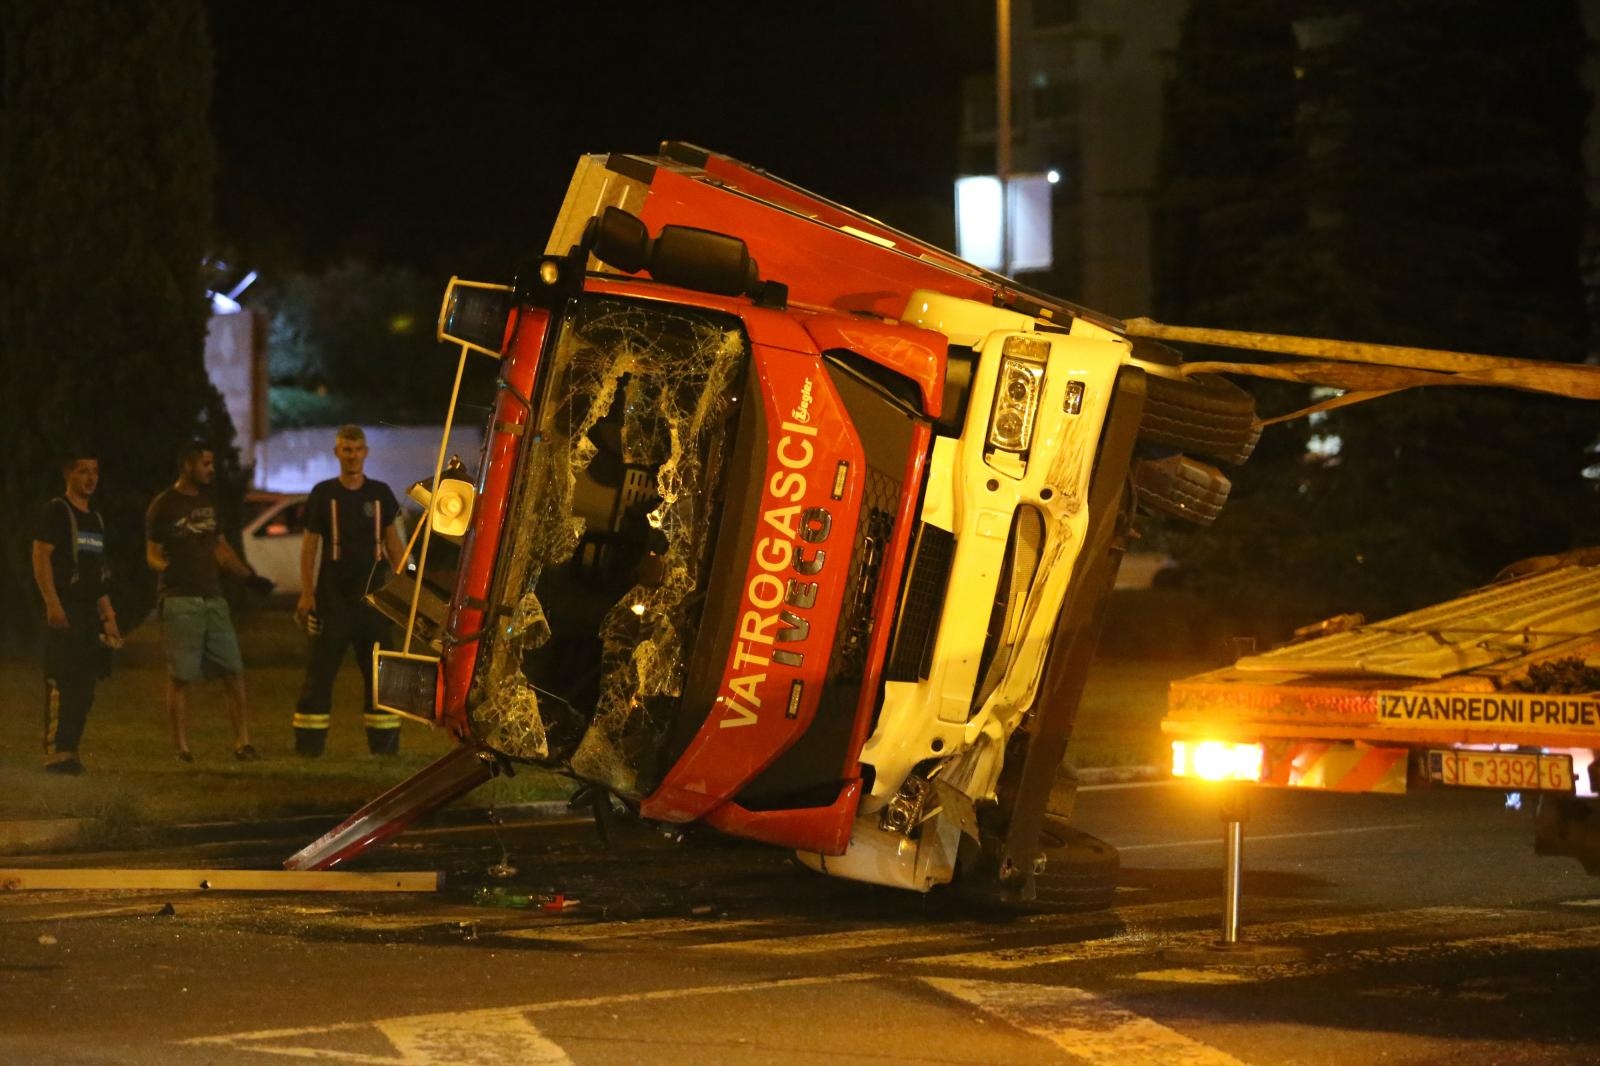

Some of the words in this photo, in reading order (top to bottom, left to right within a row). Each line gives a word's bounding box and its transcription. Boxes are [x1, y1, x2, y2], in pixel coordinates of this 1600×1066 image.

[720, 421, 818, 729] VATROGASCI
[773, 507, 832, 667] IVECO
[1381, 695, 1523, 723] IZVANREDNI
[1530, 700, 1600, 725] PRIJE
